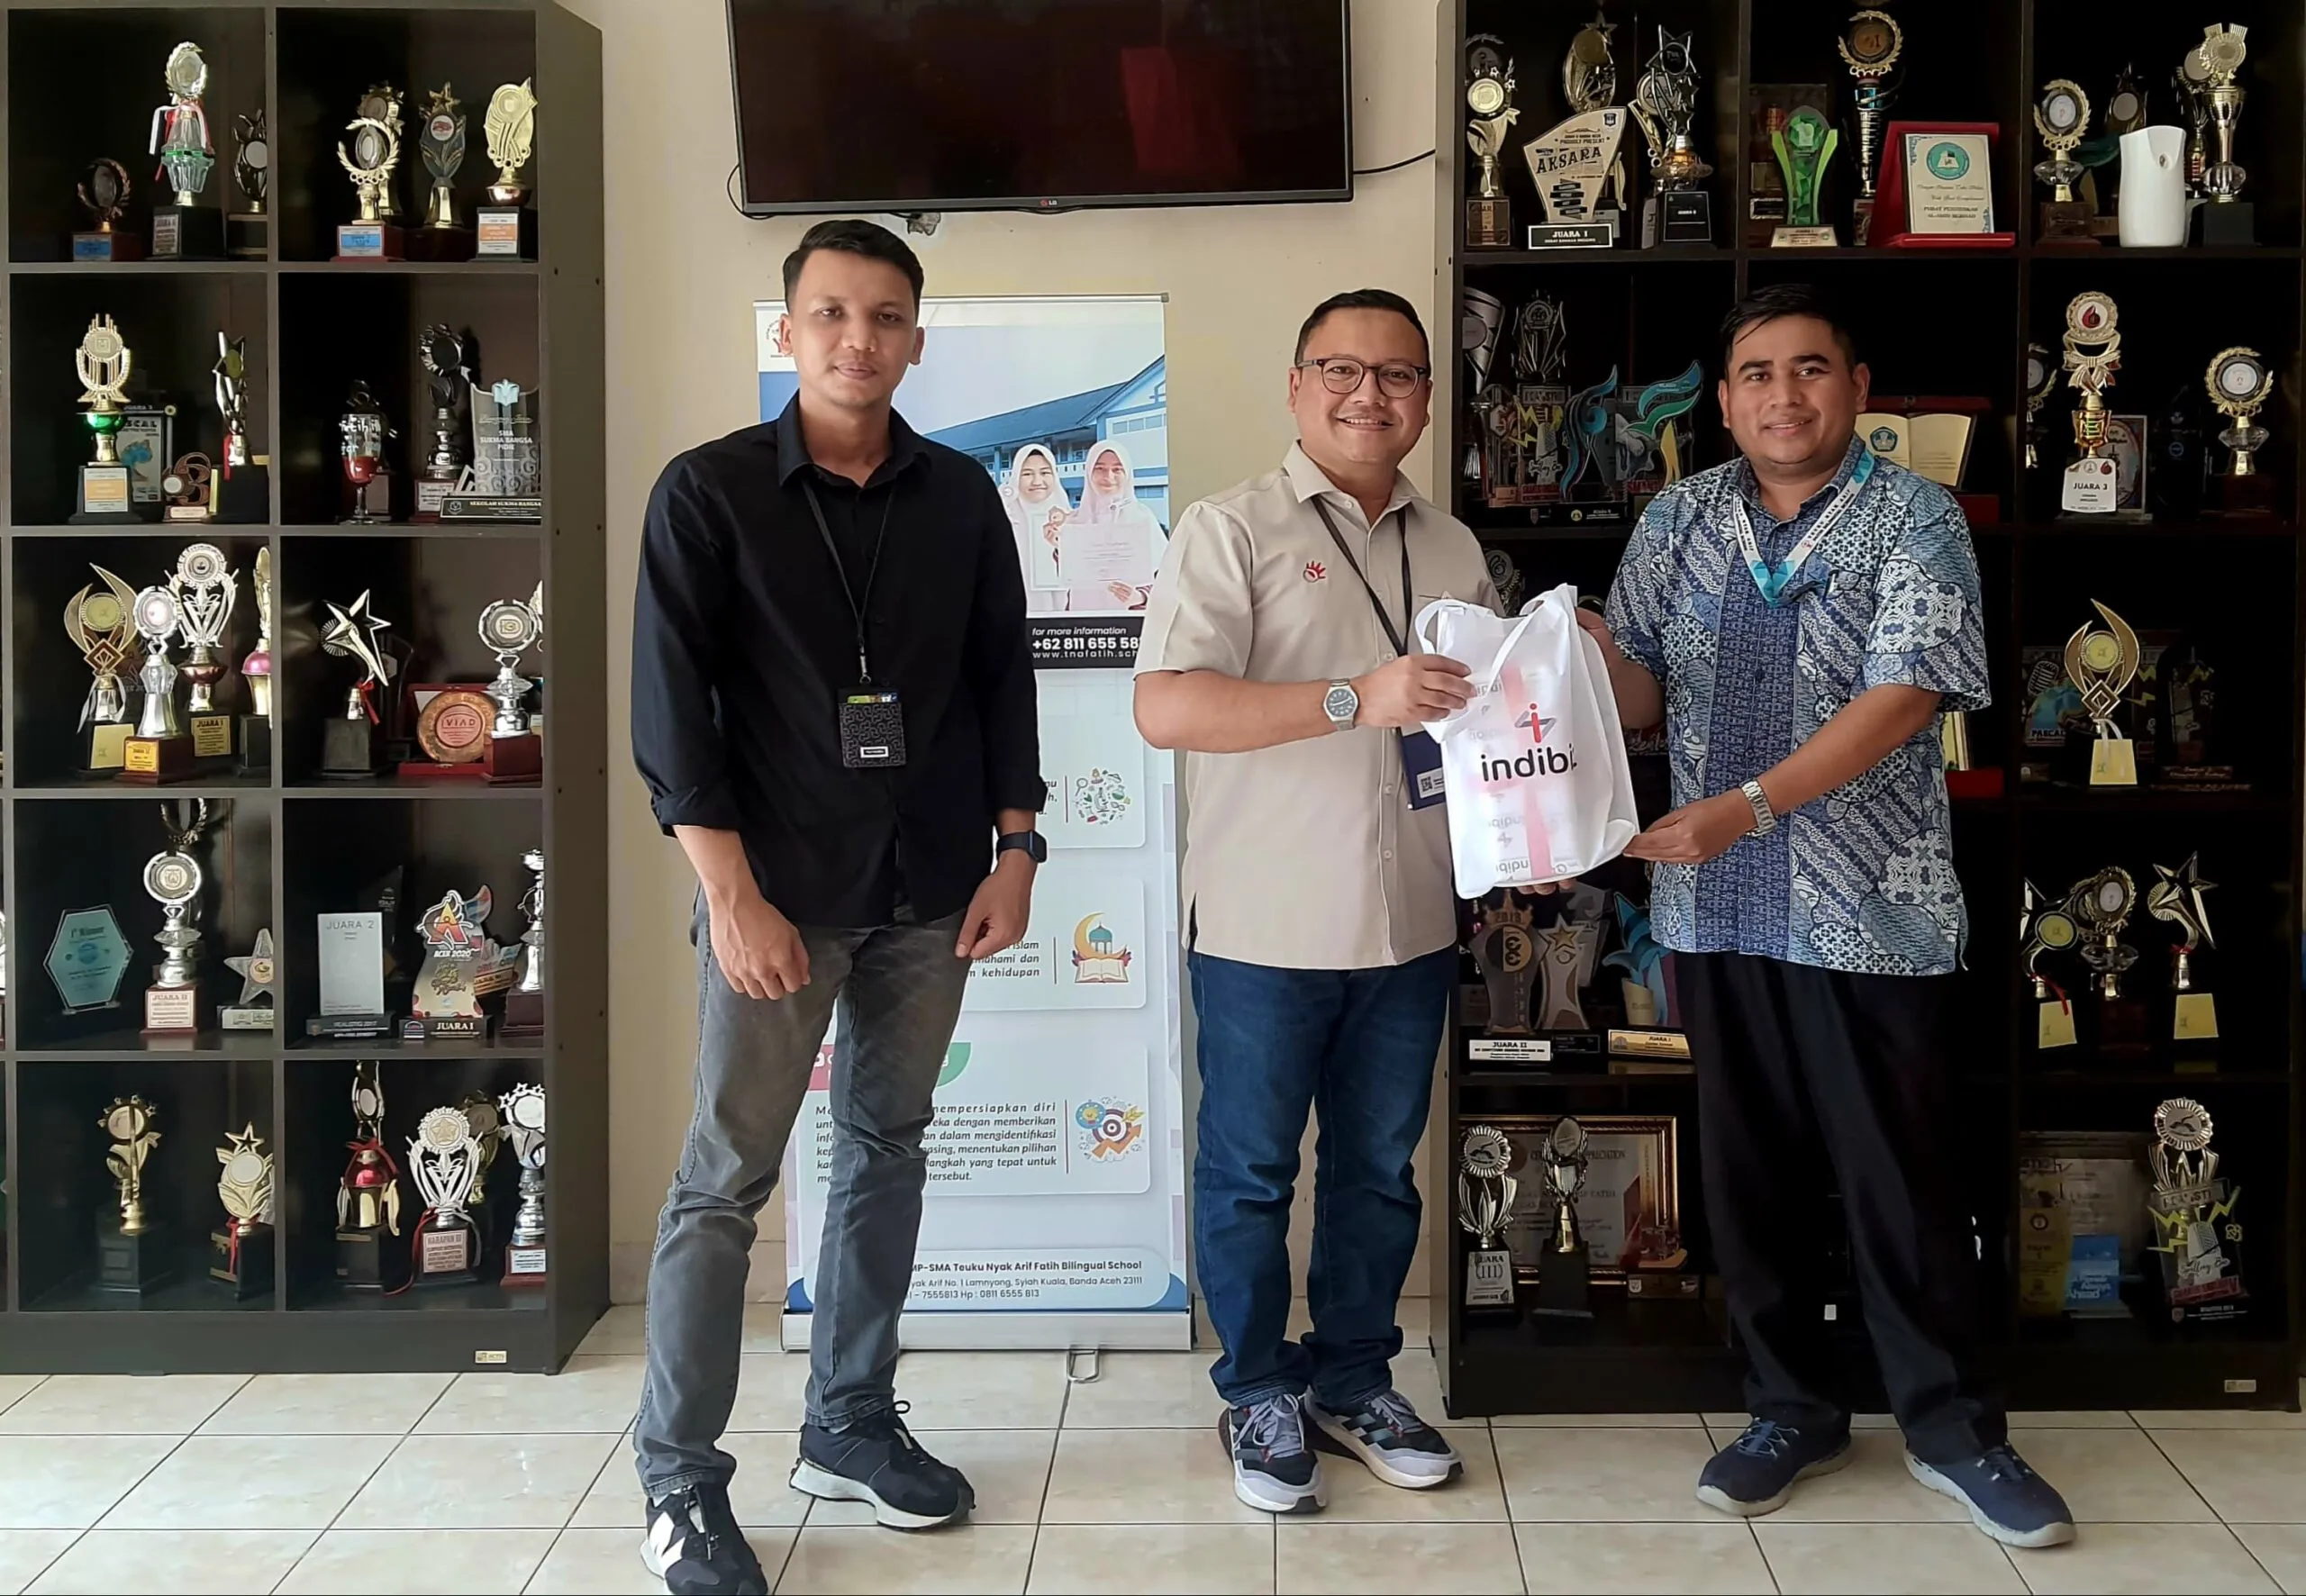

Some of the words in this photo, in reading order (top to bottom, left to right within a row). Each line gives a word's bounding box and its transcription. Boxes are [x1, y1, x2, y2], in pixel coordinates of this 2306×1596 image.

[1536, 147, 1602, 174] AKSARA
[1552, 231, 1580, 239] JUARA
[1032, 628, 1045, 636] for
[1047, 628, 1072, 636] more
[1073, 626, 1127, 635] information
[1032, 638, 1061, 650] +62
[1063, 638, 1085, 649] 811
[1087, 637, 1117, 649] 655
[1120, 637, 1141, 649] 58
[1481, 743, 1577, 782] indibi
[326, 920, 362, 929] JUARA
[368, 920, 375, 929] 2
[1020, 954, 1040, 963] dan
[982, 967, 1040, 978] kehidupan
[1033, 1102, 1056, 1112] diri
[954, 1116, 990, 1128] dengan
[994, 1116, 1056, 1126] memberikan
[940, 1131, 970, 1140] dalam
[974, 1129, 1057, 1141] mengidentifikasi
[958, 1144, 1020, 1154] menentukan
[1022, 1143, 1057, 1155] pilihan
[926, 1157, 966, 1169] langkah
[969, 1158, 994, 1169] yang
[997, 1157, 1024, 1168] tepat
[1027, 1156, 1057, 1166] untuk
[929, 1171, 972, 1182] tersebut.
[953, 1263, 984, 1272] Teuku
[986, 1262, 1012, 1274] Nyak
[1014, 1261, 1032, 1271] Arif
[1035, 1261, 1059, 1271] Fatih
[1062, 1261, 1106, 1273] Bilingual
[1108, 1260, 1142, 1270] School
[929, 1279, 943, 1287] Arif
[1015, 1277, 1039, 1288] Syiah
[1040, 1277, 1067, 1286] Kuala,
[1069, 1277, 1098, 1285] Banda
[1100, 1276, 1121, 1284] Aceh
[922, 1291, 958, 1299] 7555813
[960, 1291, 973, 1301] Hp
[980, 1290, 998, 1298] 0811
[1000, 1289, 1023, 1297] 6555
[1025, 1289, 1040, 1297] 813
